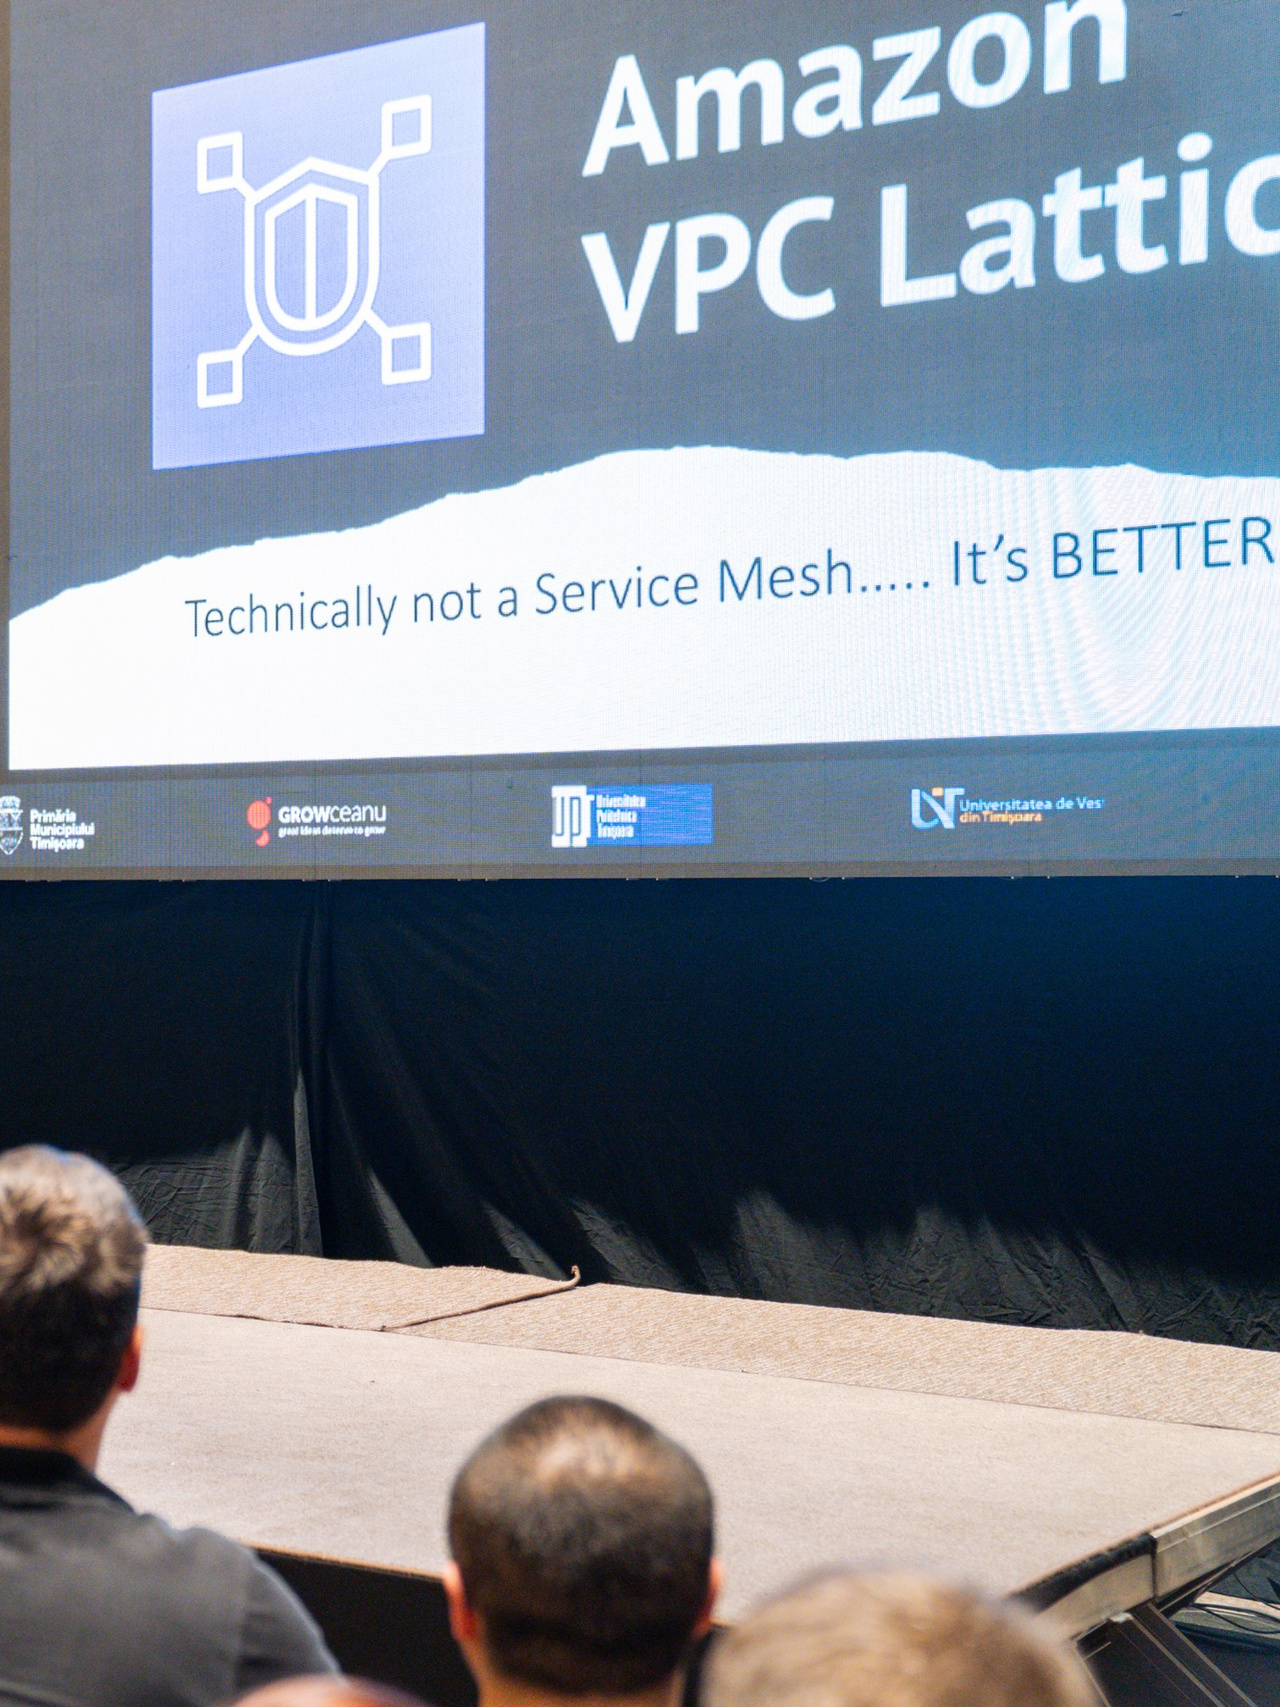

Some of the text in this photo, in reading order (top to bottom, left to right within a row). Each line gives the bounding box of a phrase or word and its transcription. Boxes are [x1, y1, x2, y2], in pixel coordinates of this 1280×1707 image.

[581, 0, 1128, 178] Amazon
[581, 132, 1280, 343] VPC Lattic
[185, 583, 397, 637] Technically
[413, 581, 482, 624] not
[497, 586, 519, 618] a
[535, 564, 699, 615] Service
[718, 547, 931, 603] Mesh.....
[1052, 515, 1276, 580] BETTER
[278, 805, 387, 824] GROWceanu
[959, 812, 980, 823] din
[1055, 797, 1074, 810] de
